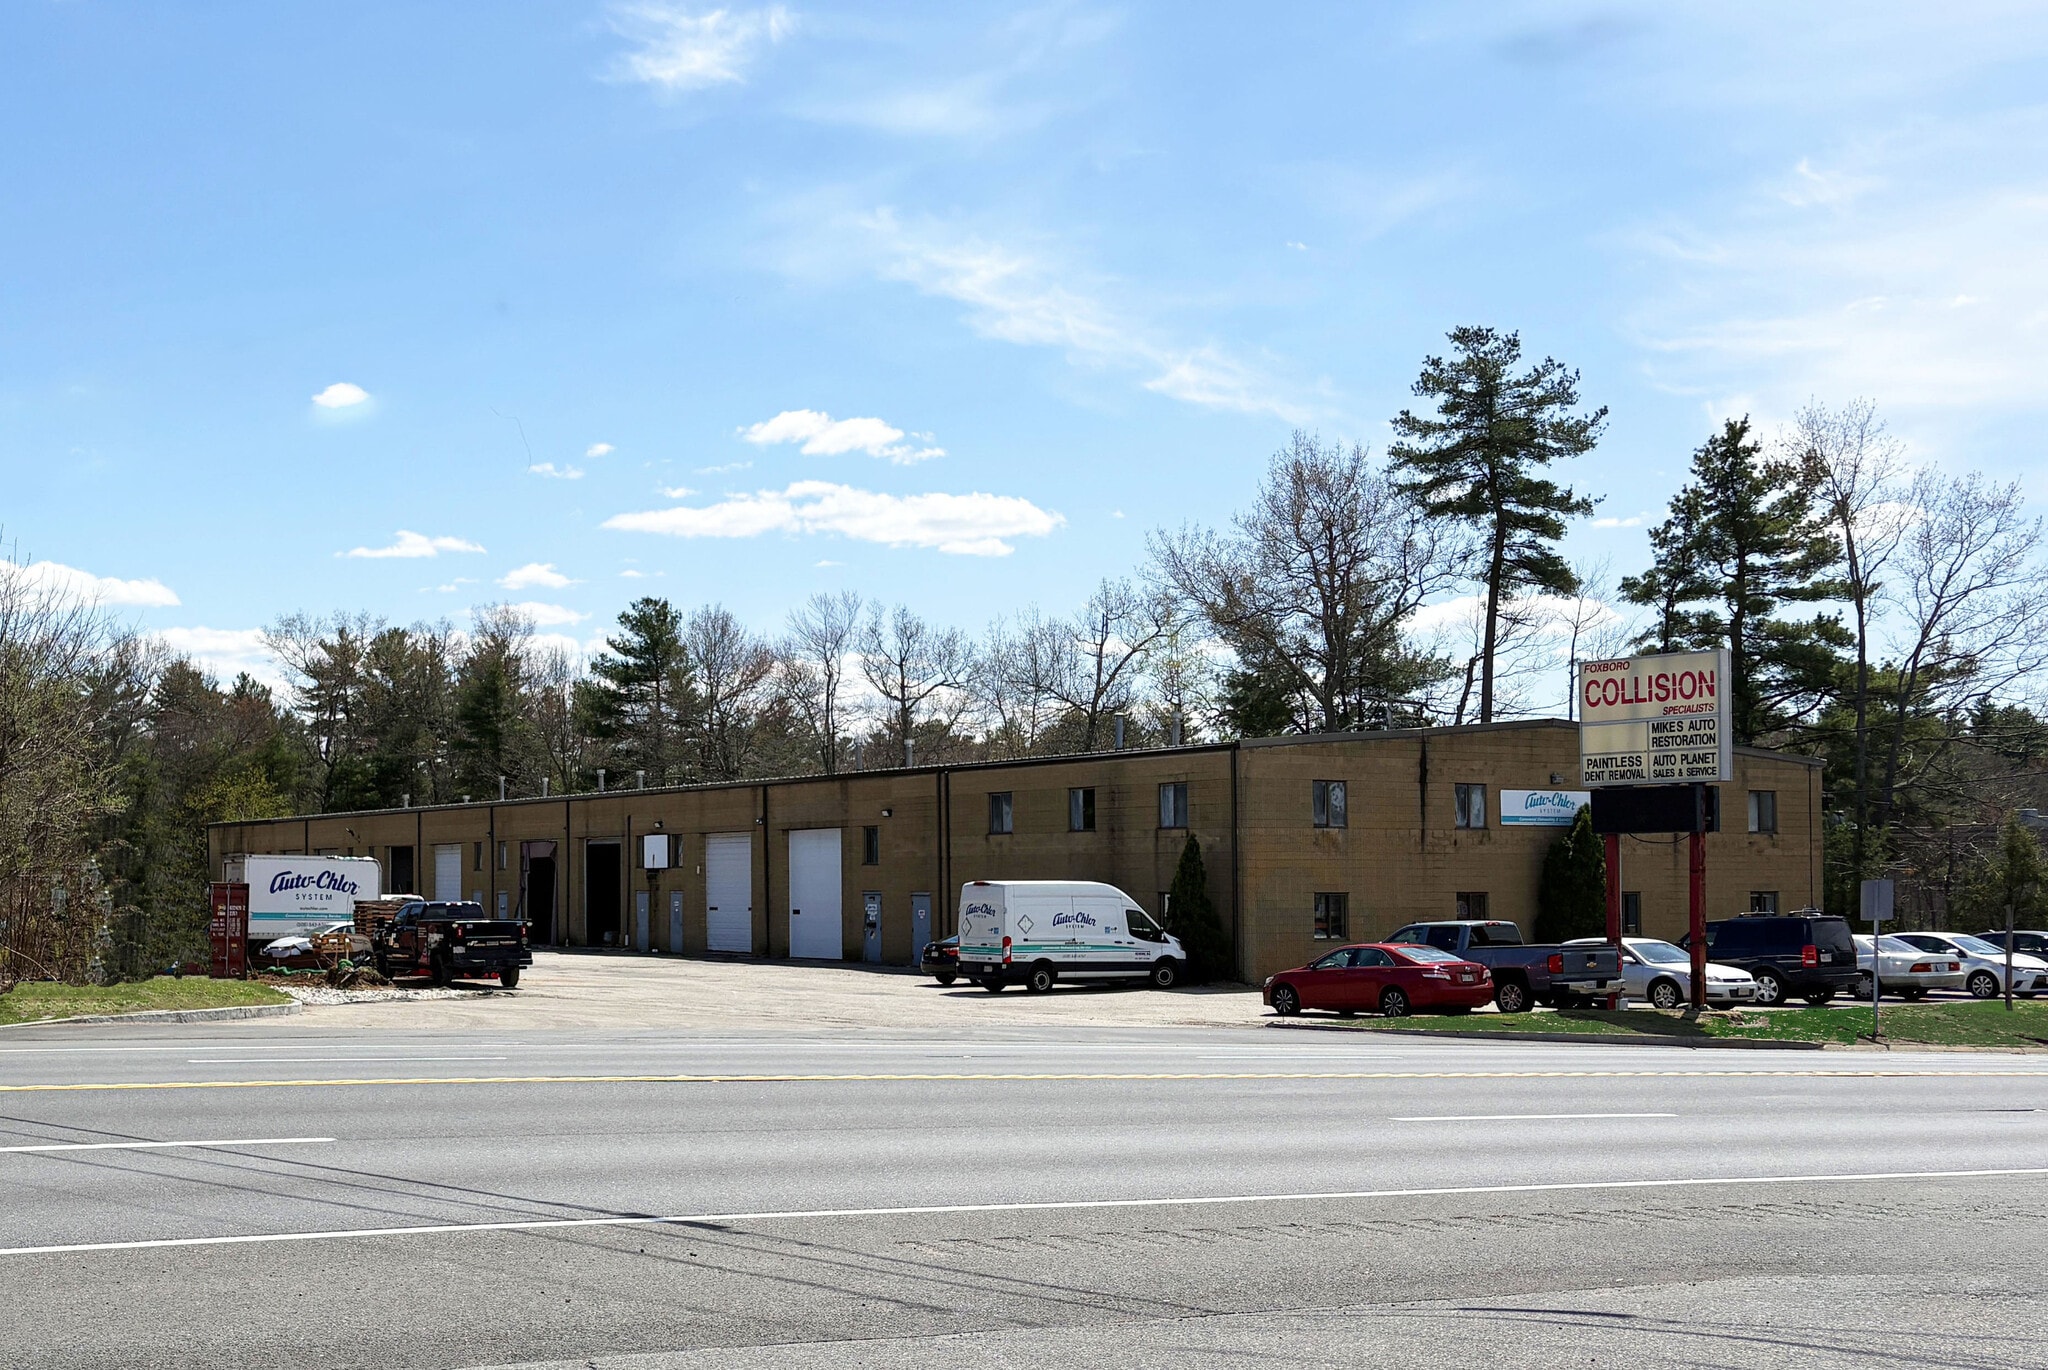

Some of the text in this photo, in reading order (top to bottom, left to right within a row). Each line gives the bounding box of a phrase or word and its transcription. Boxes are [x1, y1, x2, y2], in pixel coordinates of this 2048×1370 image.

[1584, 661, 1630, 674] FOXBORO
[1585, 670, 1715, 708] COLLISION
[1662, 703, 1715, 716] SPECIALISTS
[1651, 719, 1716, 734] MIKES AUTO
[1651, 733, 1716, 748] RESTORATION
[1586, 755, 1643, 769] PAINTLESS
[1653, 752, 1717, 767] AUTO PLANET
[1585, 768, 1646, 782] DENT REMOVAL
[1653, 766, 1717, 778] SALES & SERVICE
[1525, 792, 1576, 811] Auto-Chlor
[269, 870, 358, 895] Auto-Chlor
[966, 903, 996, 917] Auto-Chlor
[1052, 911, 1097, 926] Auto-Chlor
